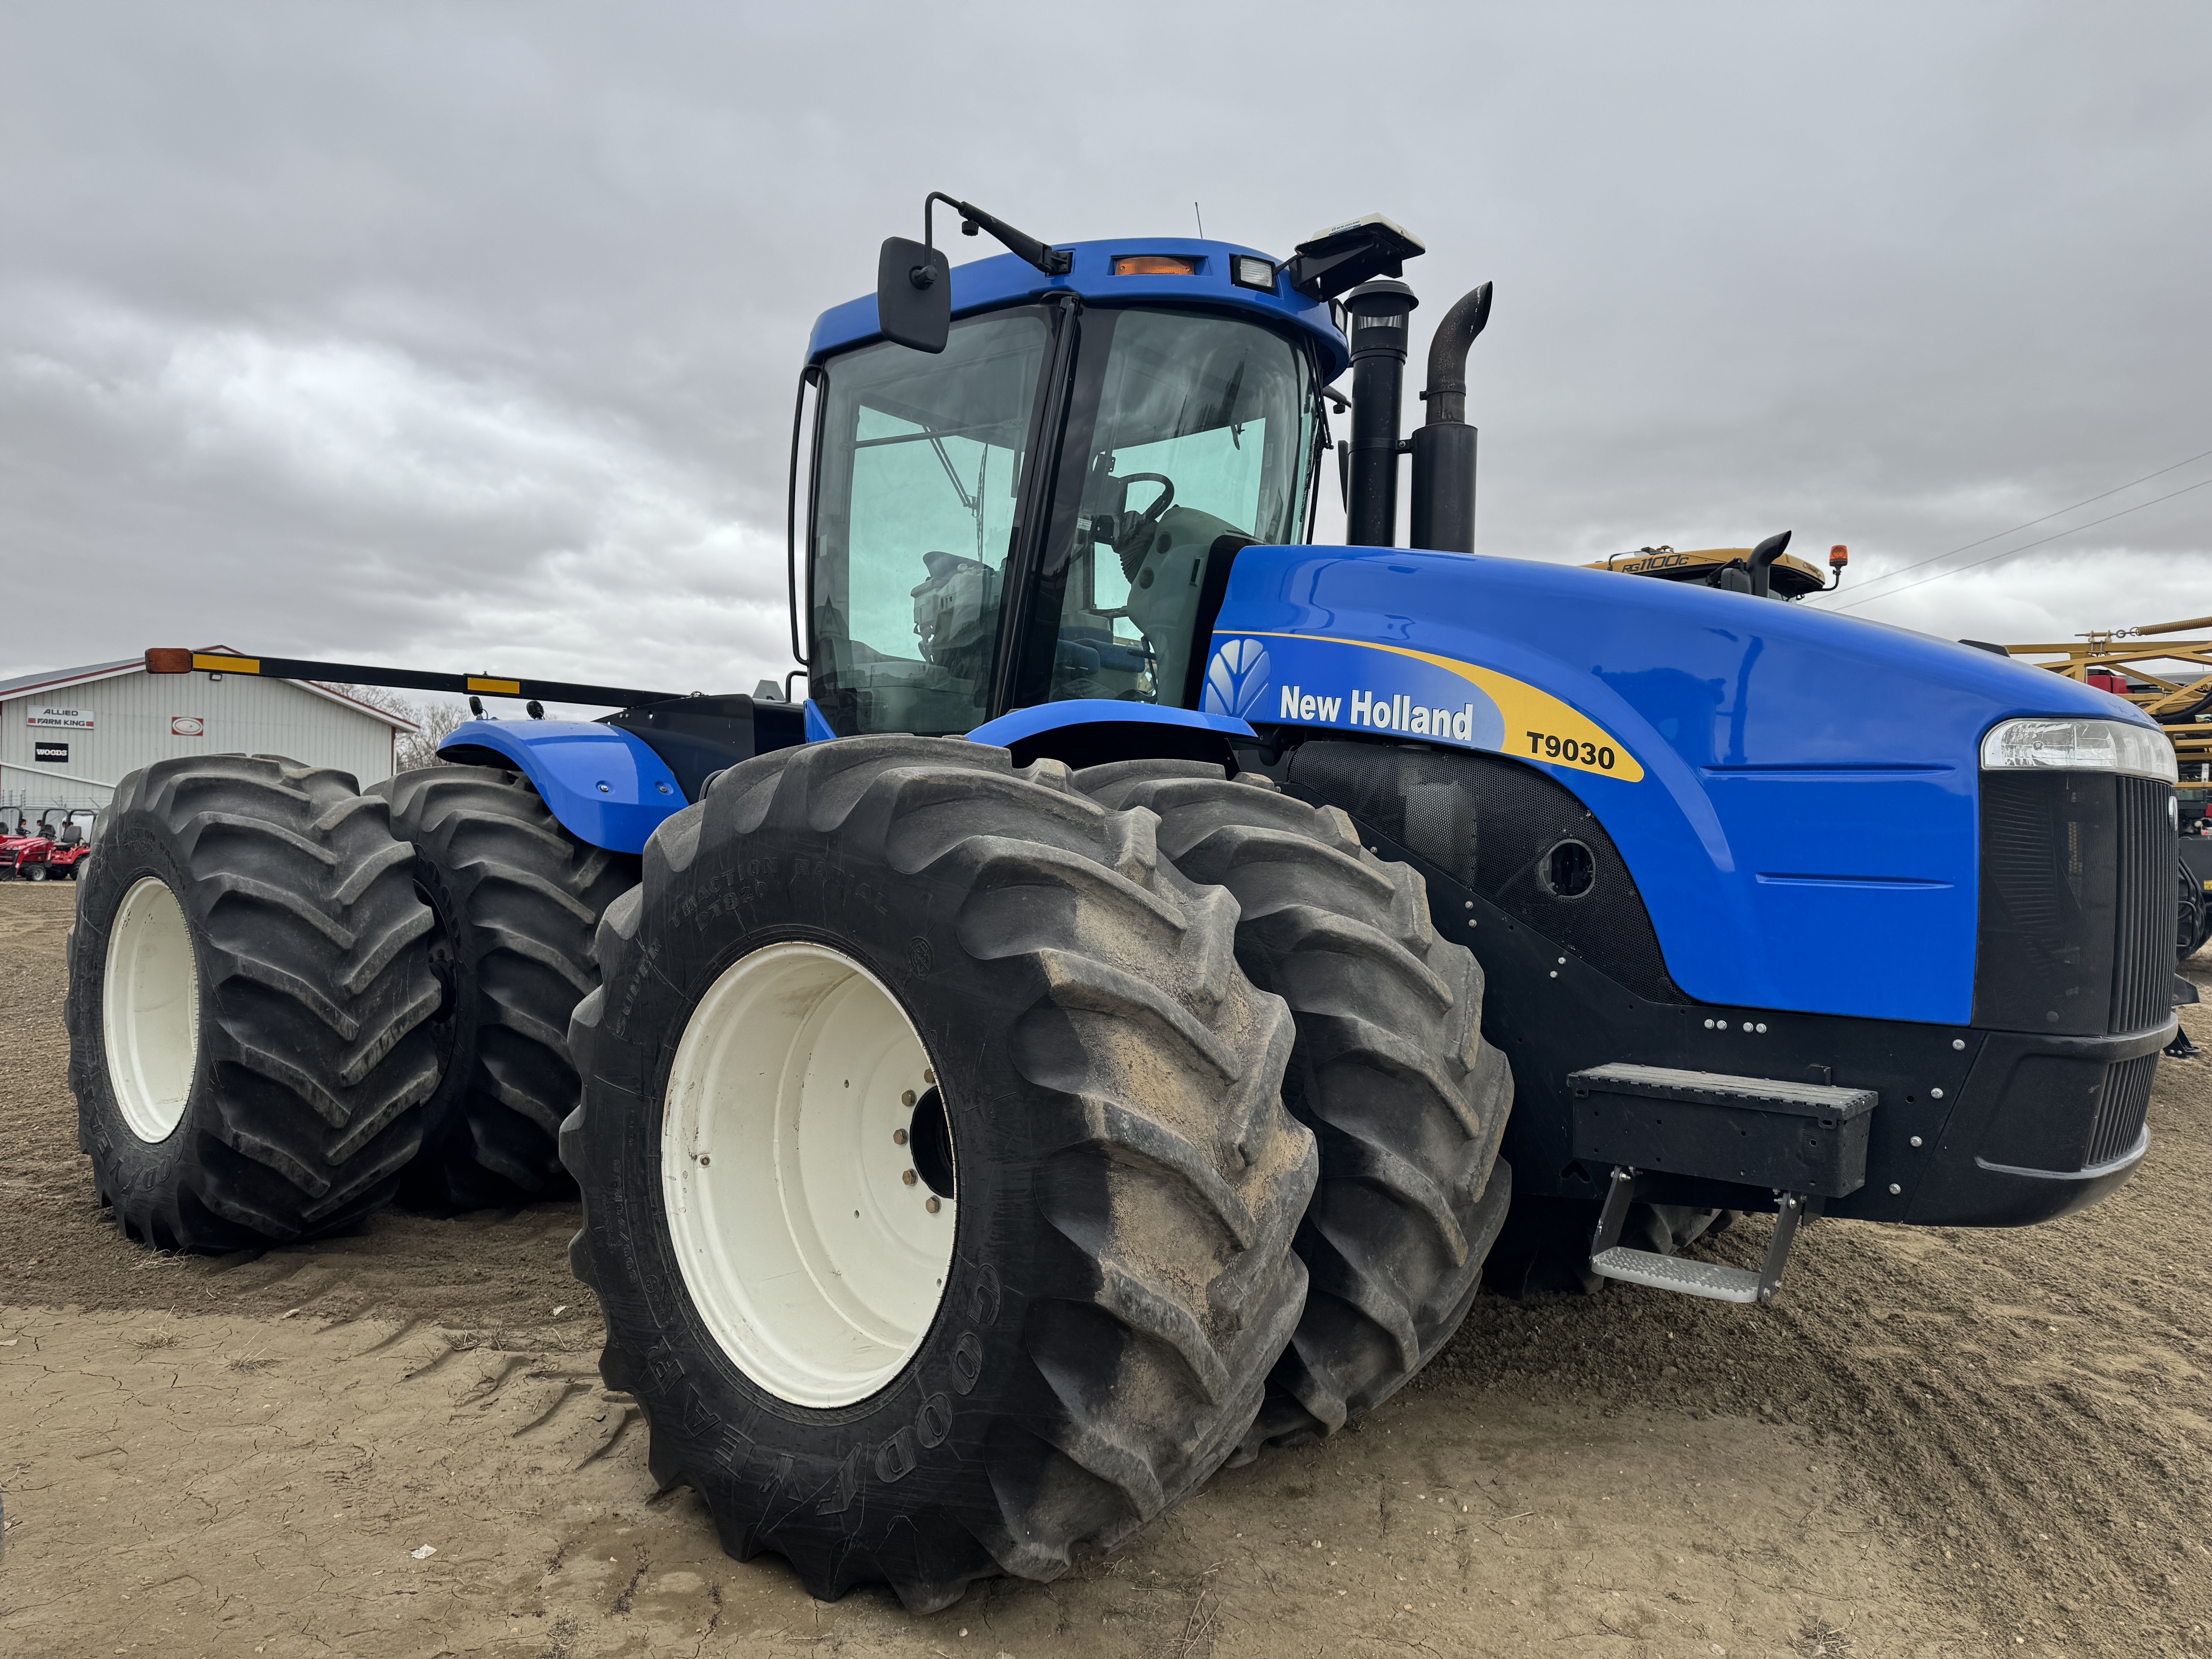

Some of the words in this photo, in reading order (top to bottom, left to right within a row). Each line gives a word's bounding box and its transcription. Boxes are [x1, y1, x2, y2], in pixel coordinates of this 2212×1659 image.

[1280, 685, 1341, 723] New
[1351, 689, 1473, 741] Holland
[1526, 730, 1615, 770] T9030
[695, 881, 769, 932] DT820
[615, 938, 663, 1037] SUPER
[668, 857, 778, 929] TRACTION
[795, 858, 890, 917] RADIAL
